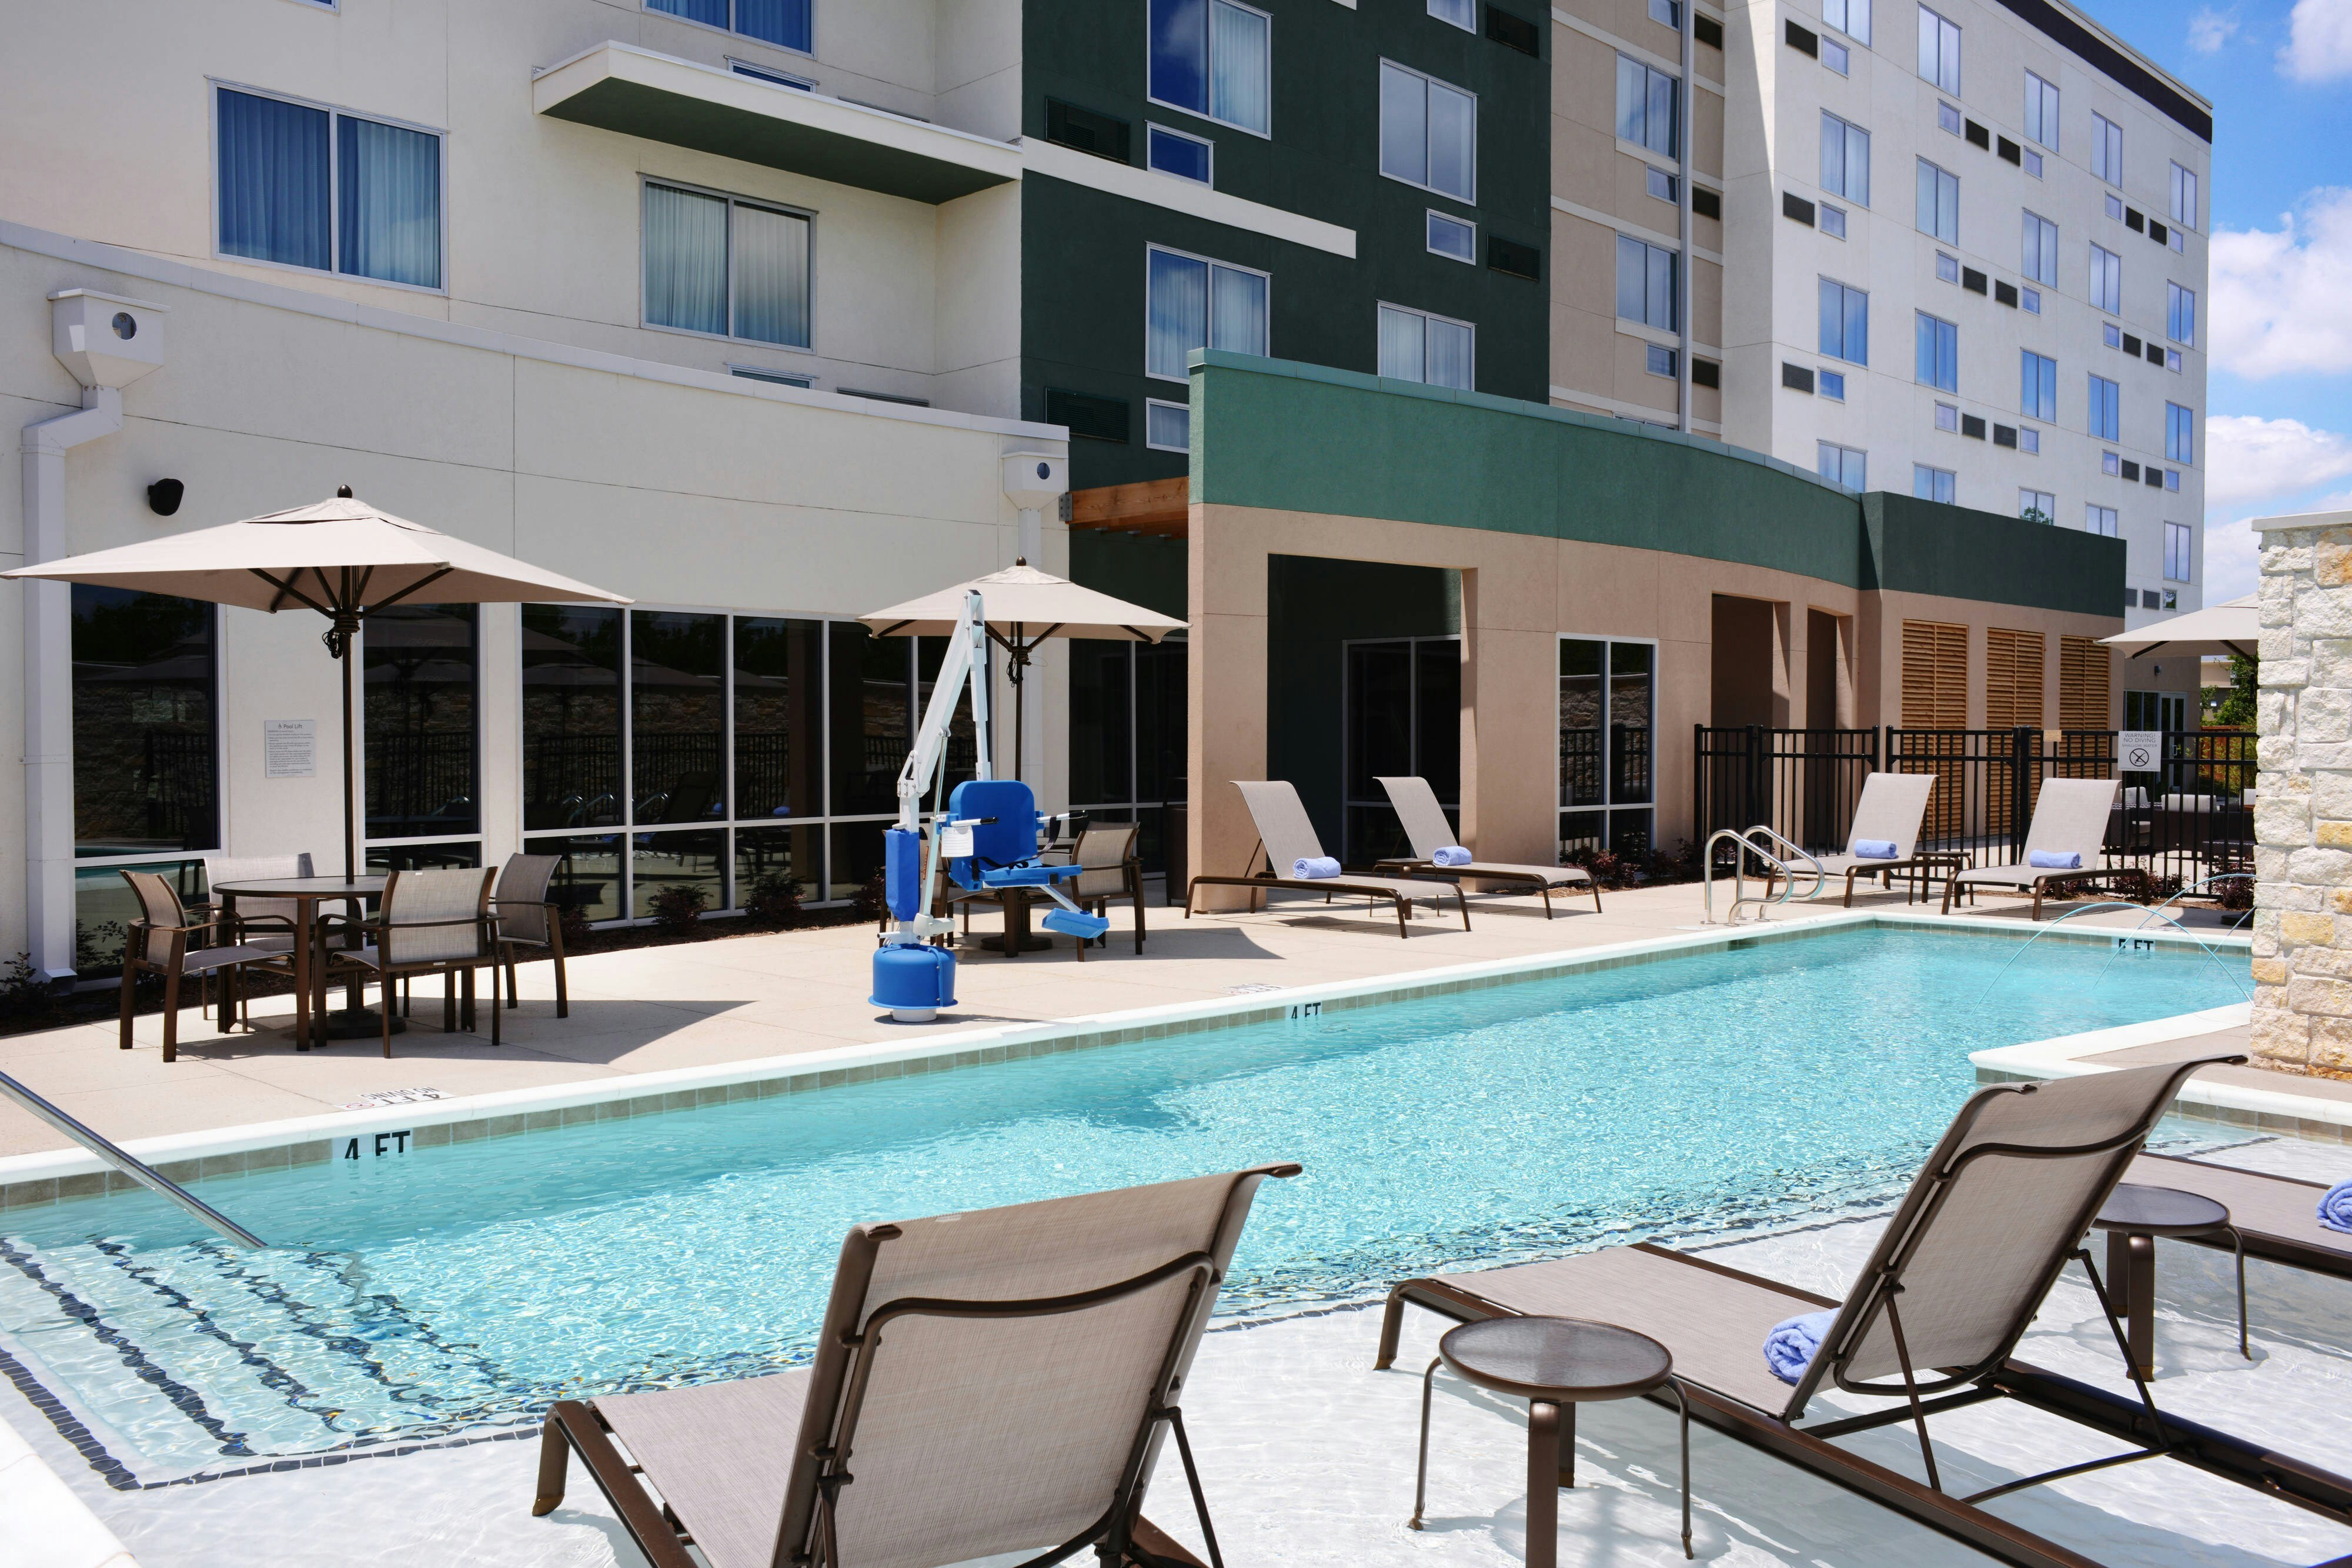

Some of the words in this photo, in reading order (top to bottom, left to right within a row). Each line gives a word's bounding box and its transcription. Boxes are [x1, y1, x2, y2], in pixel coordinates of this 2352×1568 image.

[2134, 940, 2154, 950] FT
[1291, 1005, 1298, 1019] 4
[1305, 1002, 1321, 1018] FT
[360, 1089, 415, 1099] DIVING
[381, 1096, 418, 1105] FT
[345, 1137, 361, 1160] 4
[375, 1130, 410, 1156] FT
